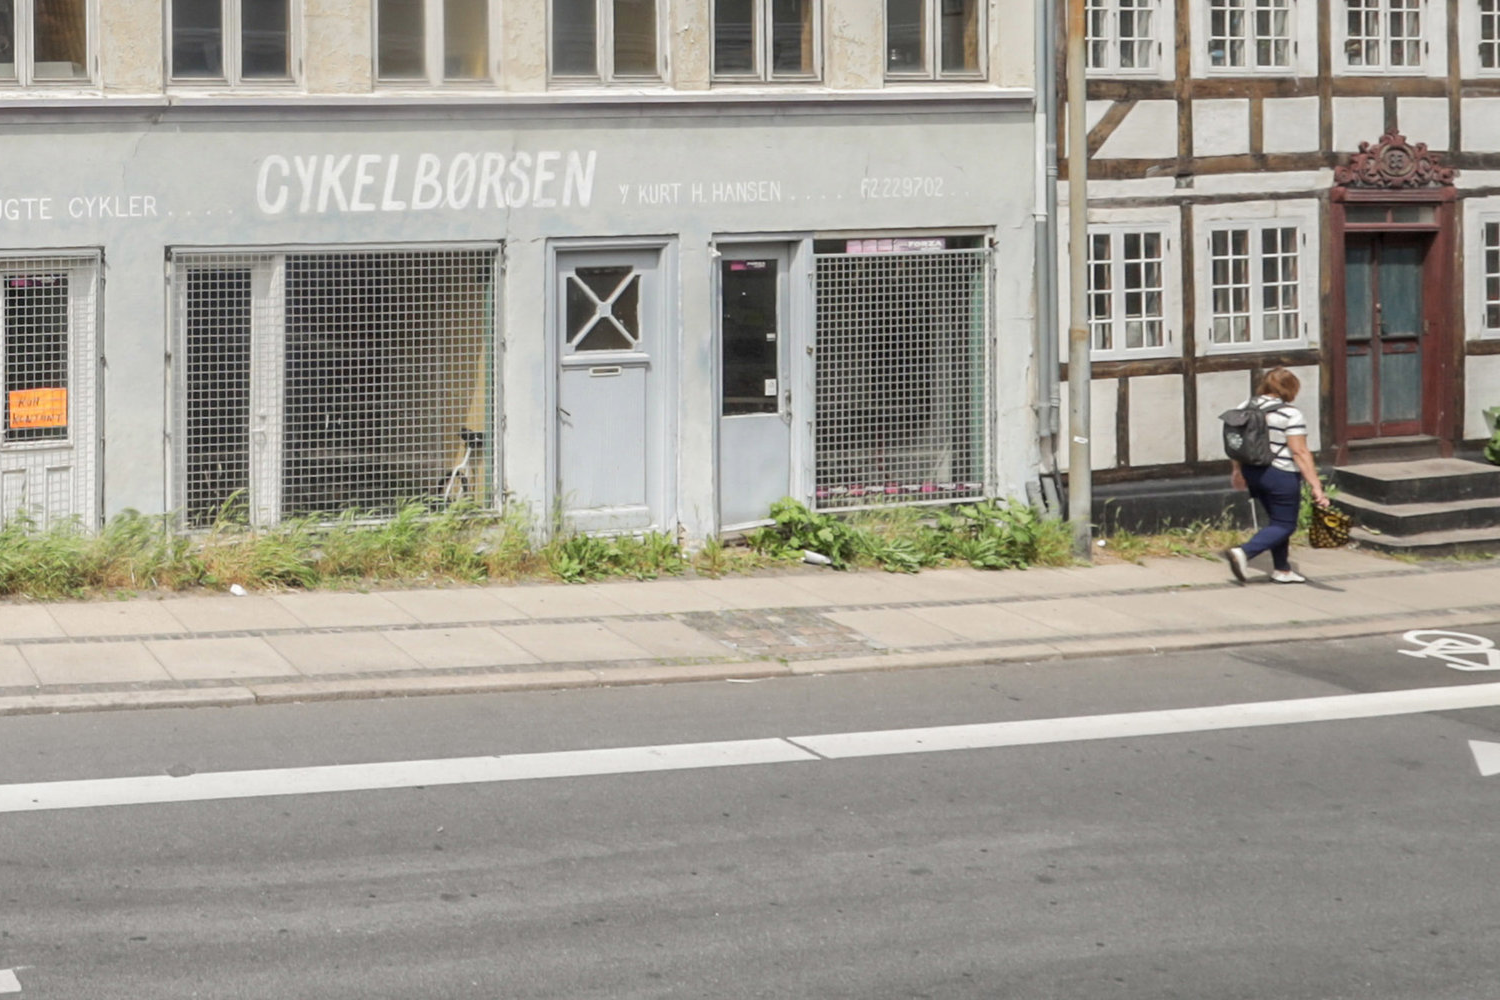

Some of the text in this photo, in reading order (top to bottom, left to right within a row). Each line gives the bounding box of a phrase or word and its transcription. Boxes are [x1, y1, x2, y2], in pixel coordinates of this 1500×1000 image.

[256, 150, 597, 215] CYKELBØRSEN
[638, 182, 682, 204] KURT
[691, 181, 707, 203] H.
[712, 180, 782, 203] HANSEN
[68, 195, 158, 219] CYKLER
